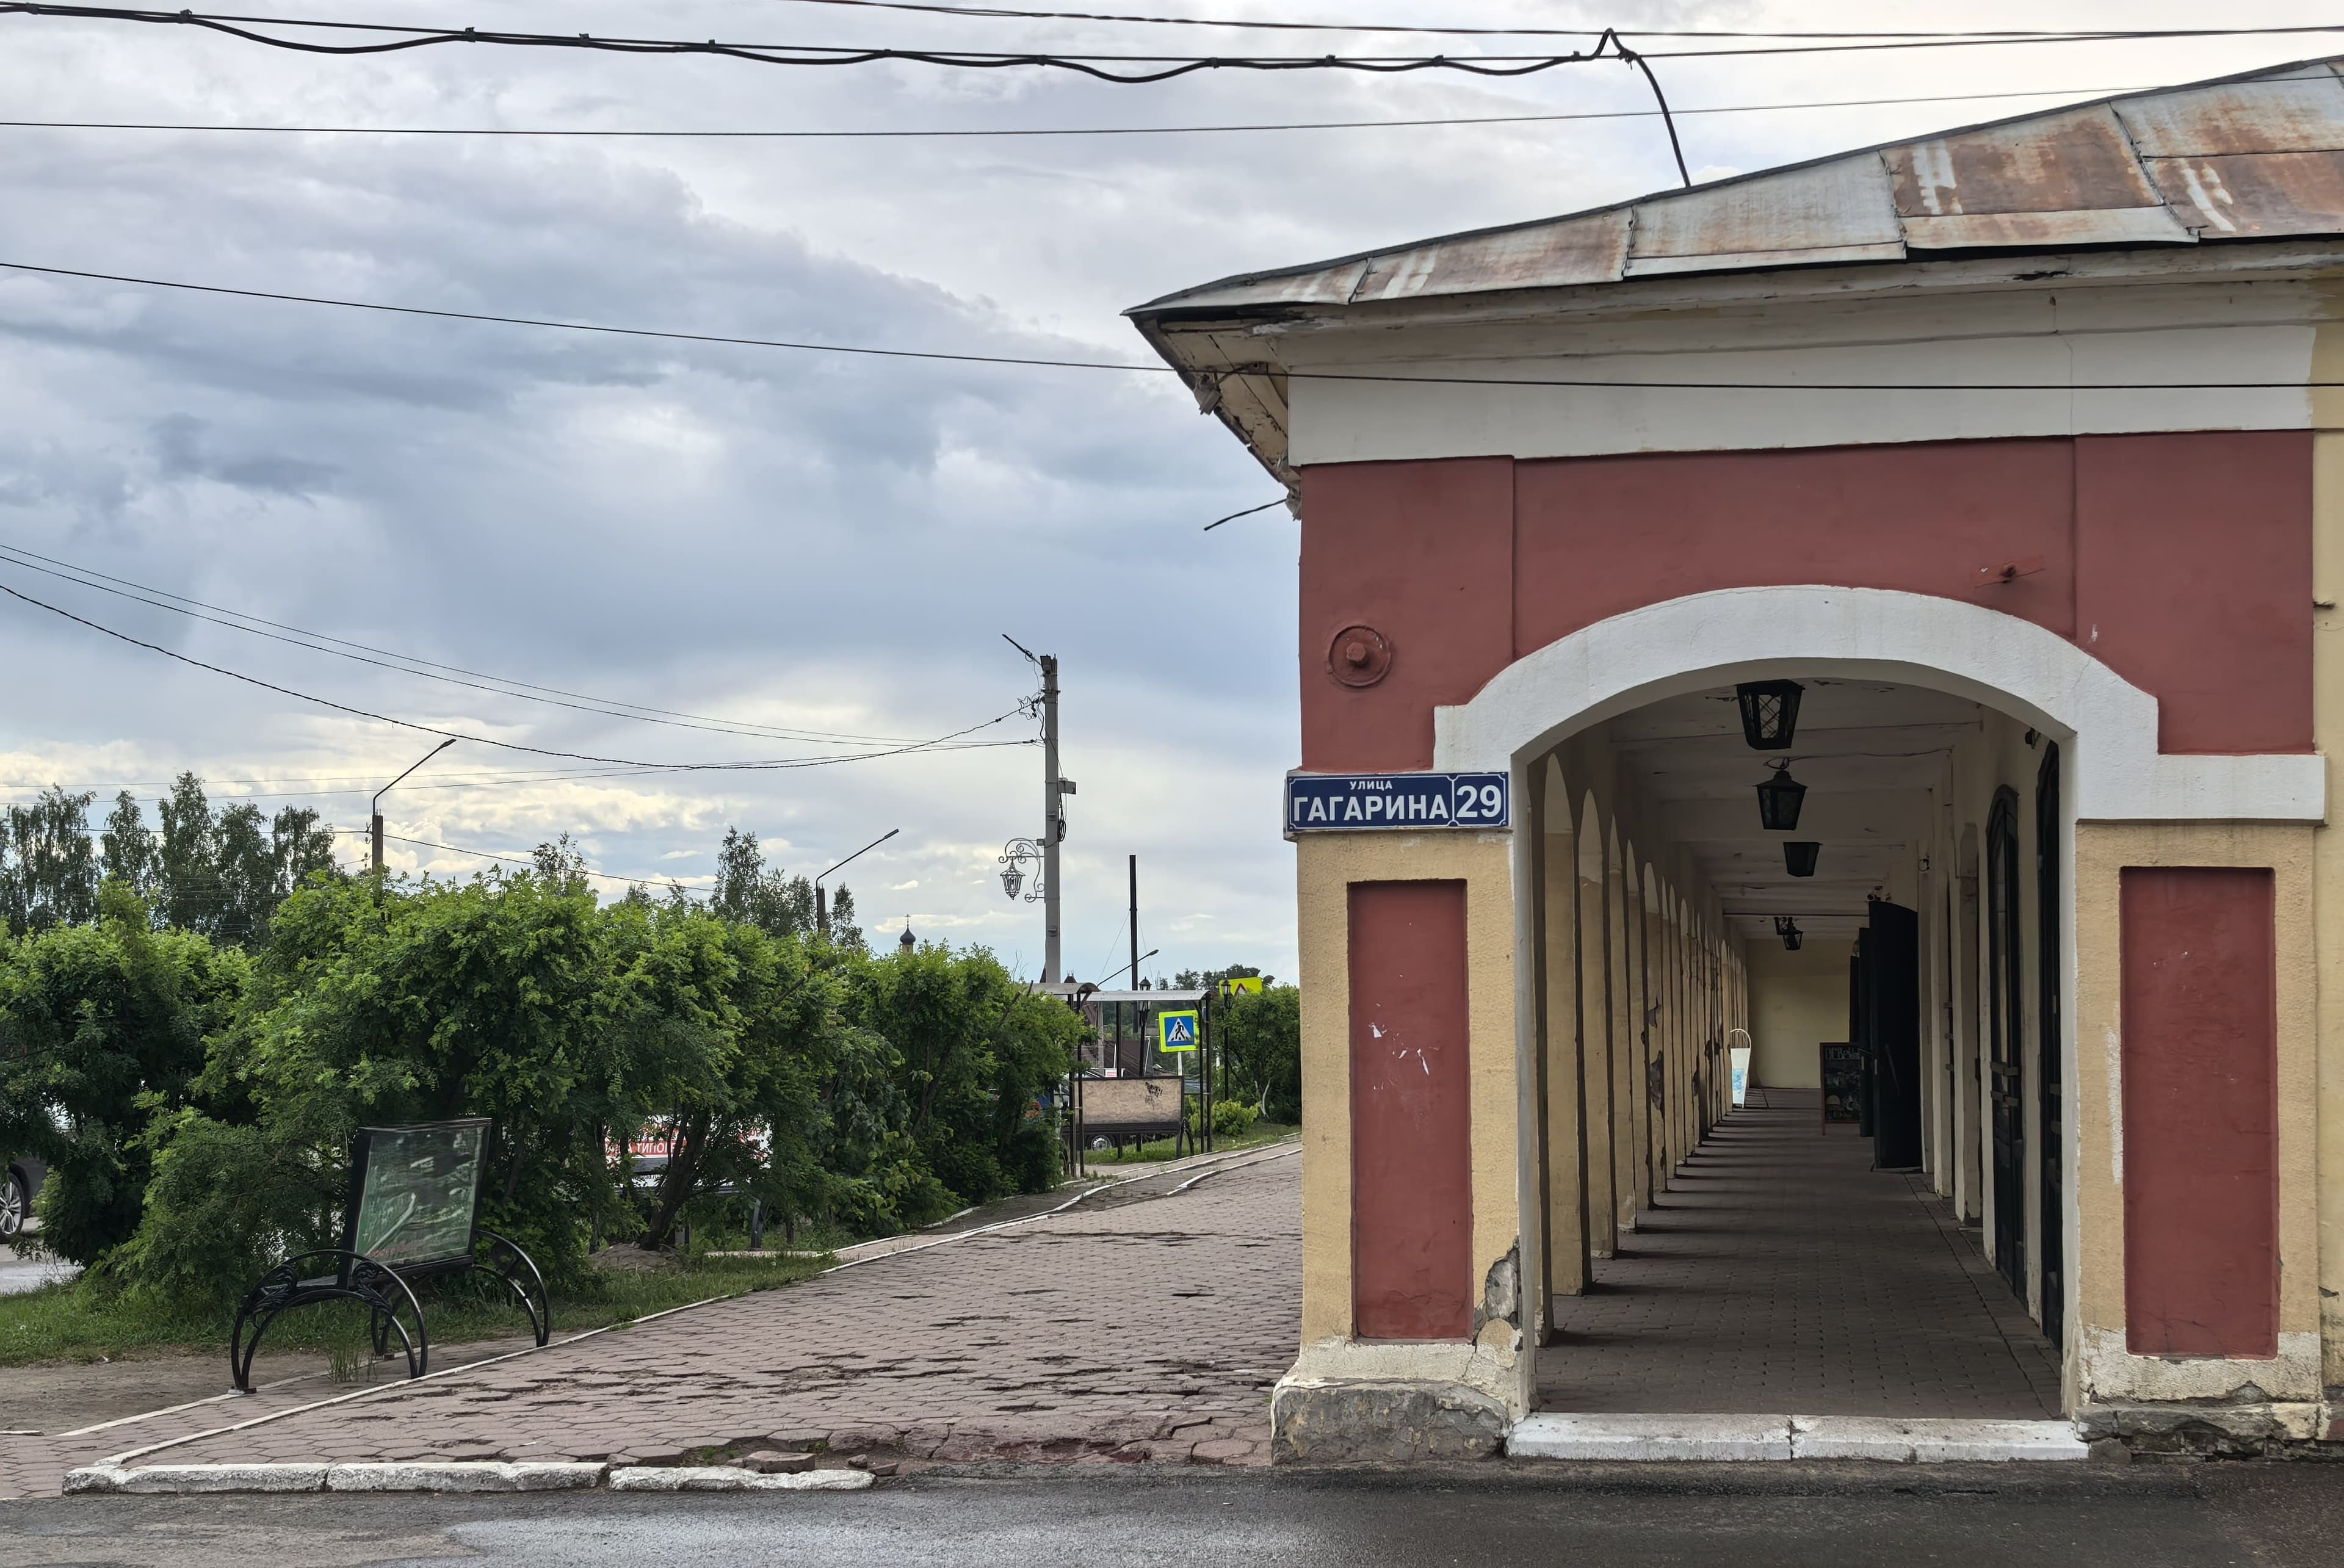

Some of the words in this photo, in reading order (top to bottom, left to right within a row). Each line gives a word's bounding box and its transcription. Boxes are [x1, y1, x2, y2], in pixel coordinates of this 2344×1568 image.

[1350, 781, 1392, 790] УЛИЦА
[1293, 795, 1449, 822] ГАГАРИНА
[1456, 785, 1502, 818] 29
